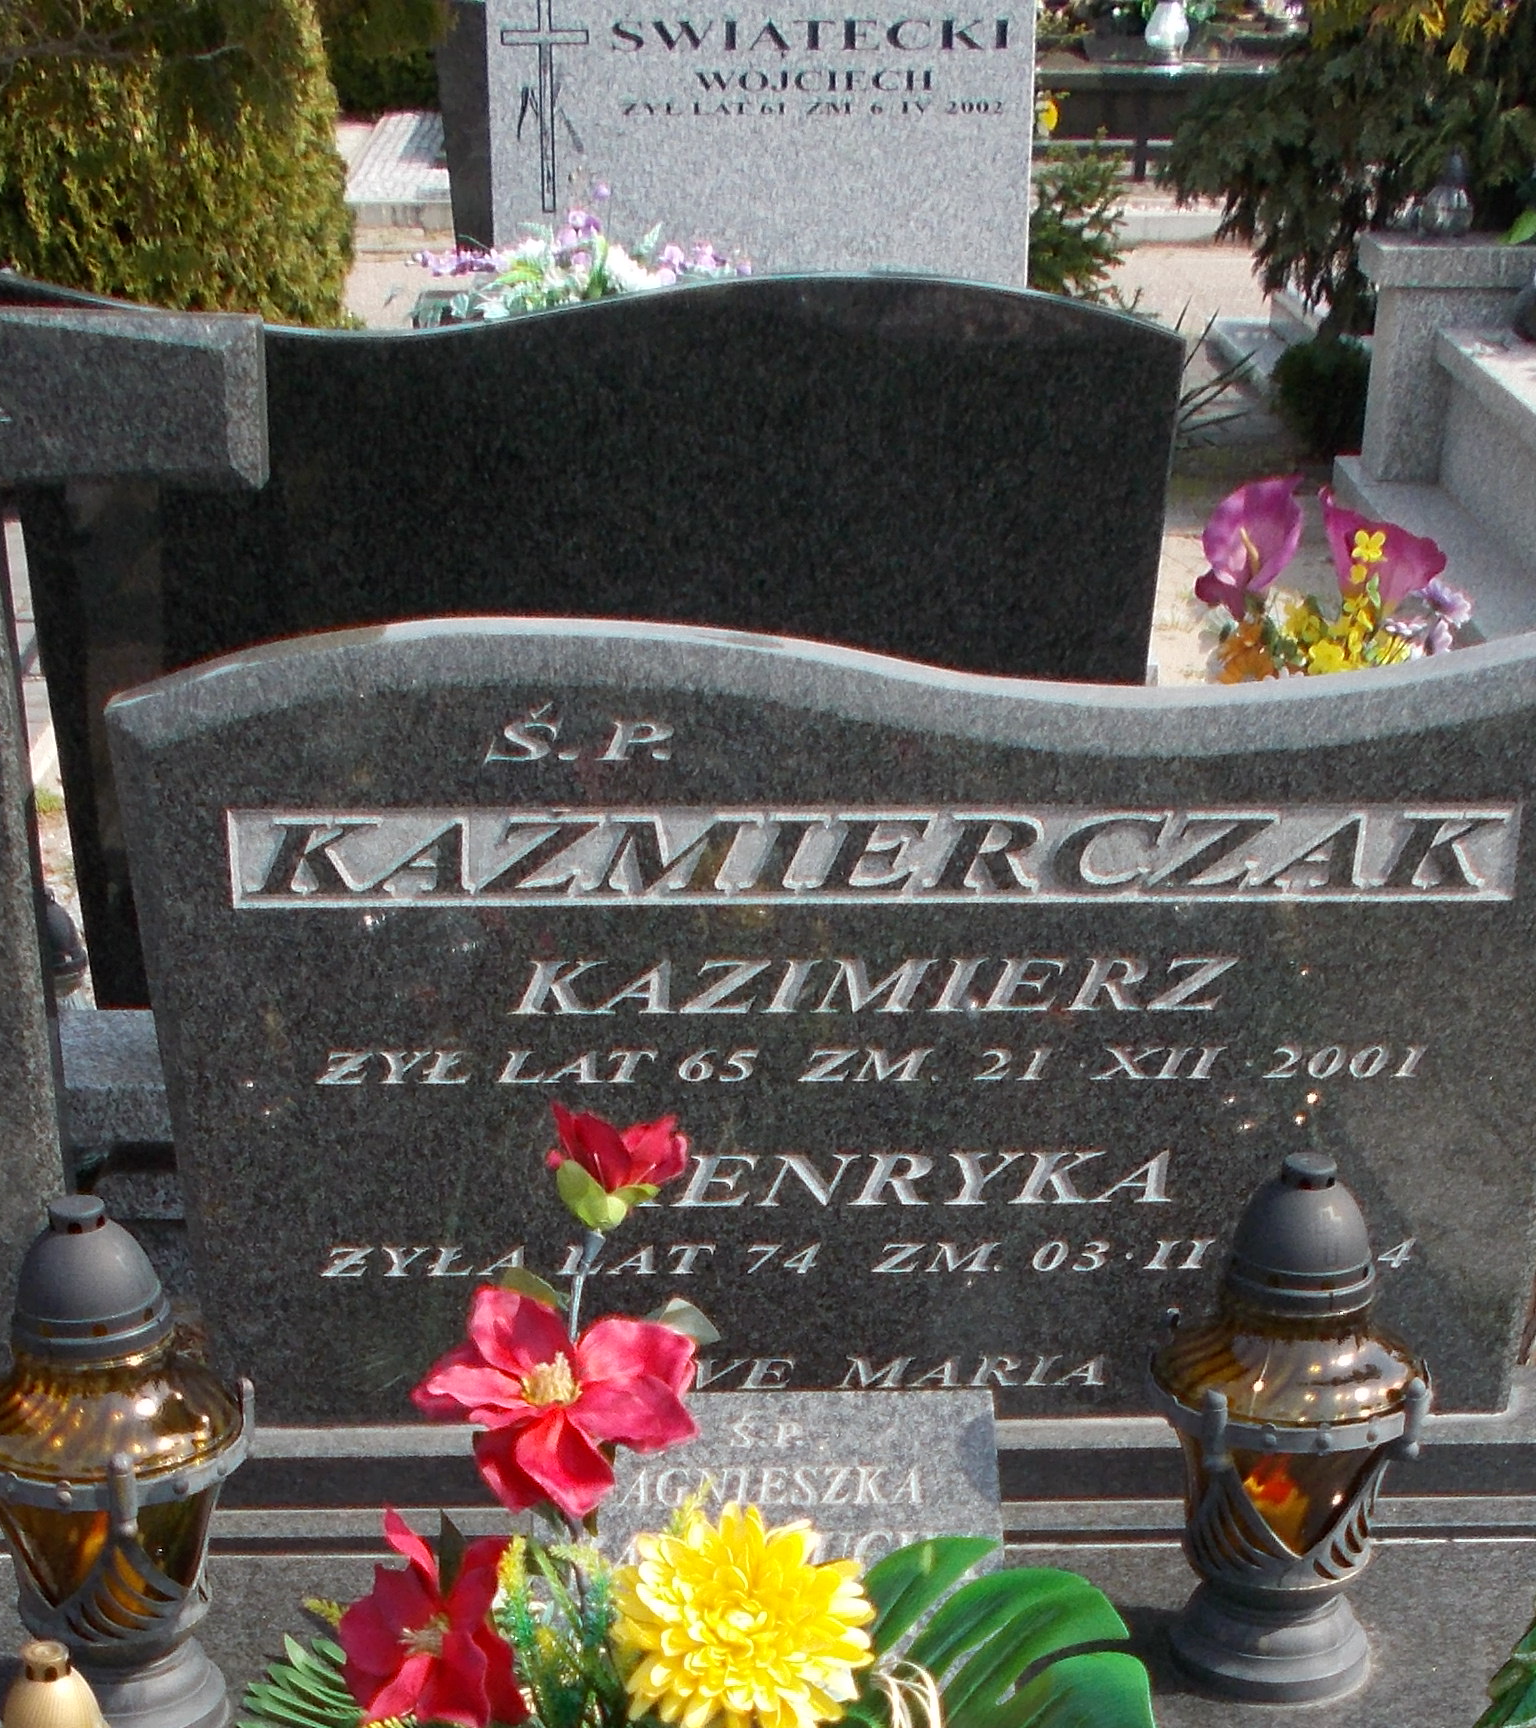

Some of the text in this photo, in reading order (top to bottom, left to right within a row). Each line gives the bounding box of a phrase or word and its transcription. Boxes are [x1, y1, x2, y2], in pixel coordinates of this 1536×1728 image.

[694, 68, 936, 93] WOJCIECH
[870, 101, 884, 115] 6
[945, 100, 1005, 116] 2002
[508, 955, 1241, 1016] KAZIMIERZ
[496, 1048, 656, 1085] LAT
[677, 1047, 759, 1083] 65
[798, 1047, 940, 1083] ZM.
[638, 1152, 1172, 1209] ENRYKA
[555, 1244, 718, 1276] LAT
[745, 1243, 822, 1276] 74
[870, 1241, 1002, 1273] ZM.
[691, 1354, 1110, 1390] VE MARIA
[617, 1465, 926, 1505] AGNIESZKA
